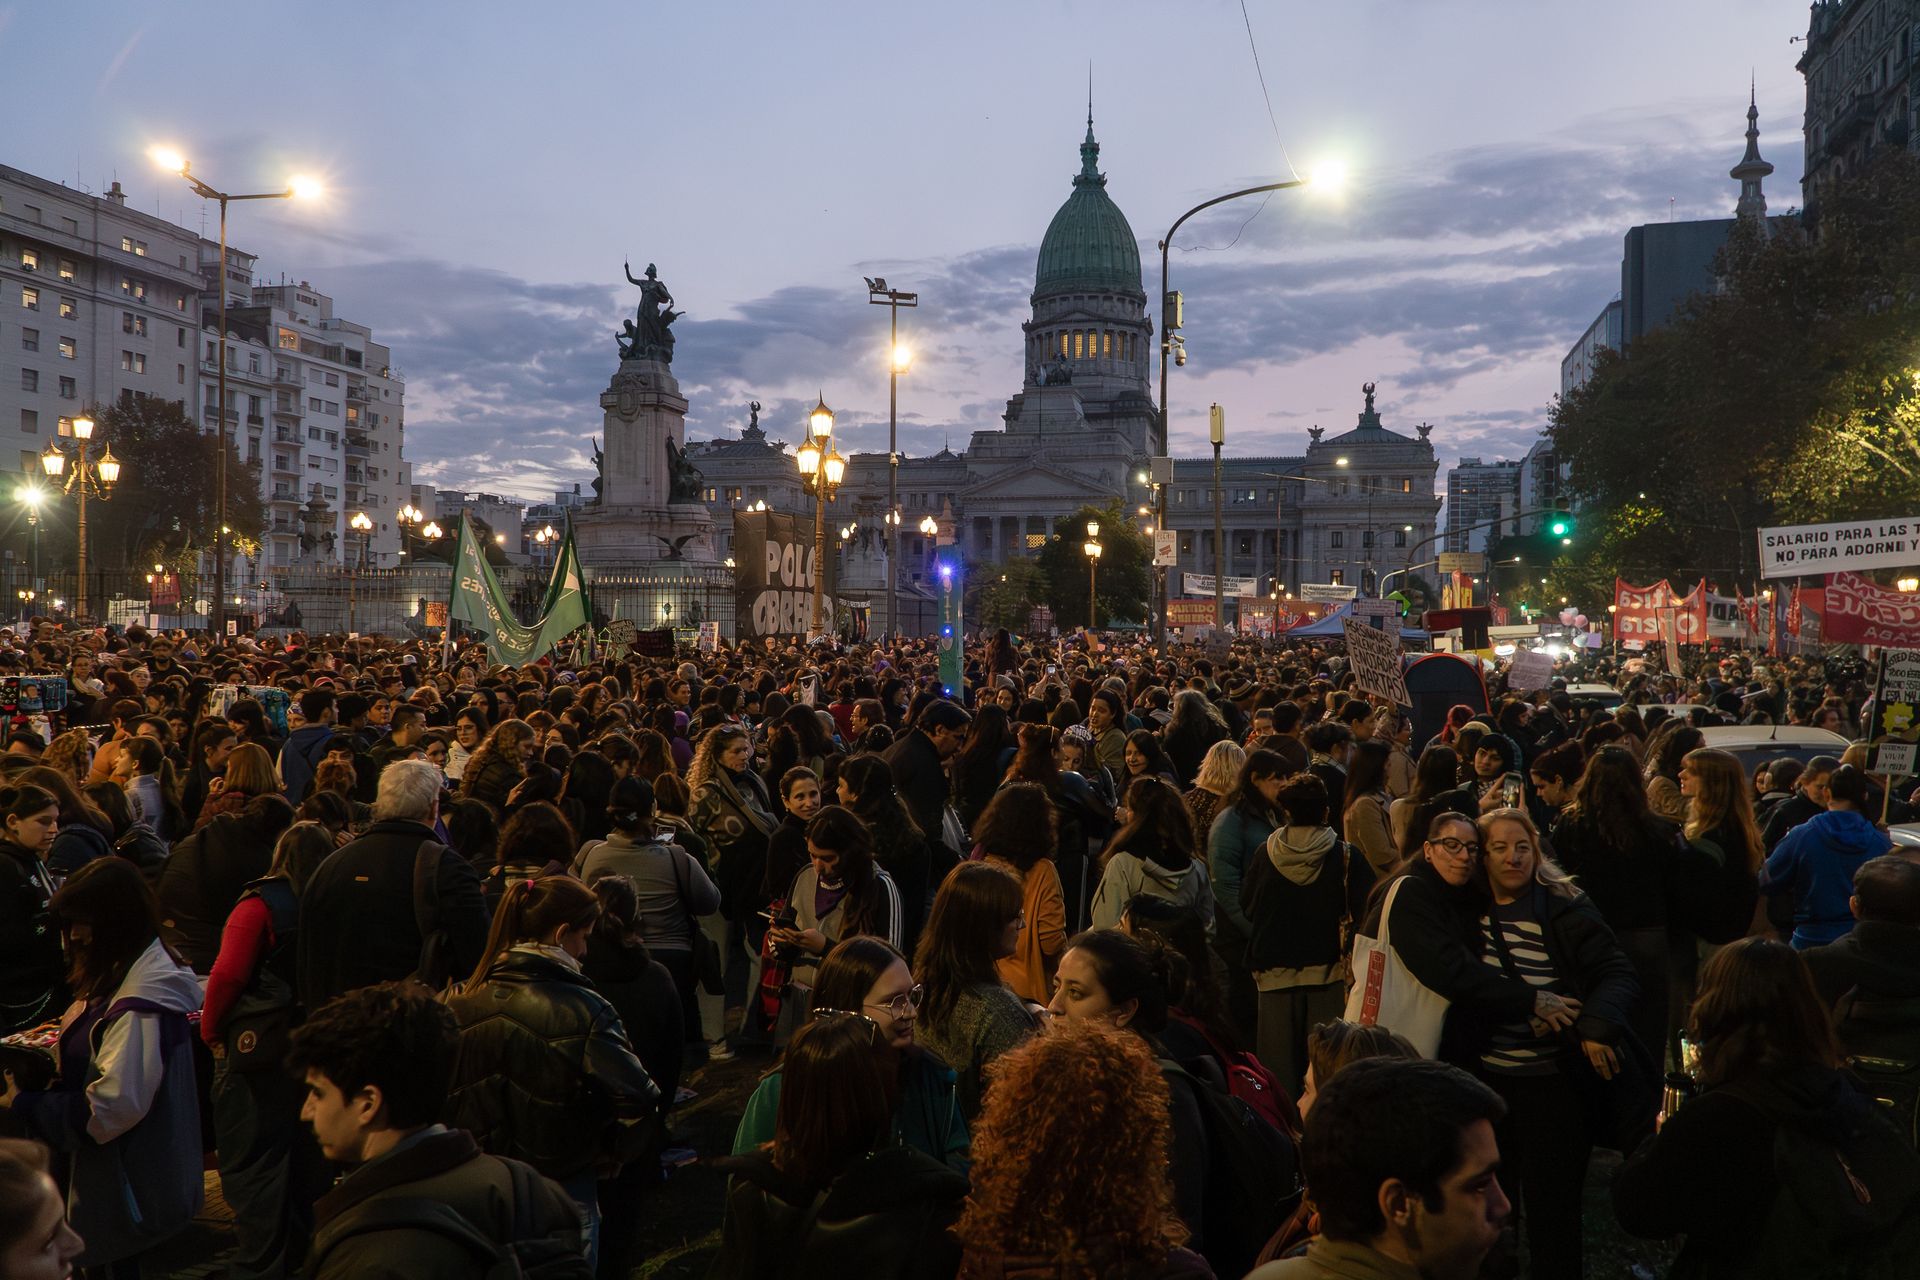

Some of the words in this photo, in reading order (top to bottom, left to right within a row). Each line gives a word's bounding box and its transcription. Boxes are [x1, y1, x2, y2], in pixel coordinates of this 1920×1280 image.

[1766, 531, 1828, 547] SALARIO
[1836, 527, 1872, 541] PARA
[1880, 524, 1907, 537] LAS
[766, 540, 816, 588] POLO
[1776, 550, 1795, 562] NO
[1801, 546, 1838, 560] PARA
[753, 589, 834, 637] OBRERO
[1167, 603, 1215, 613] PARTIDO
[1352, 647, 1401, 679] ENOJADAS
